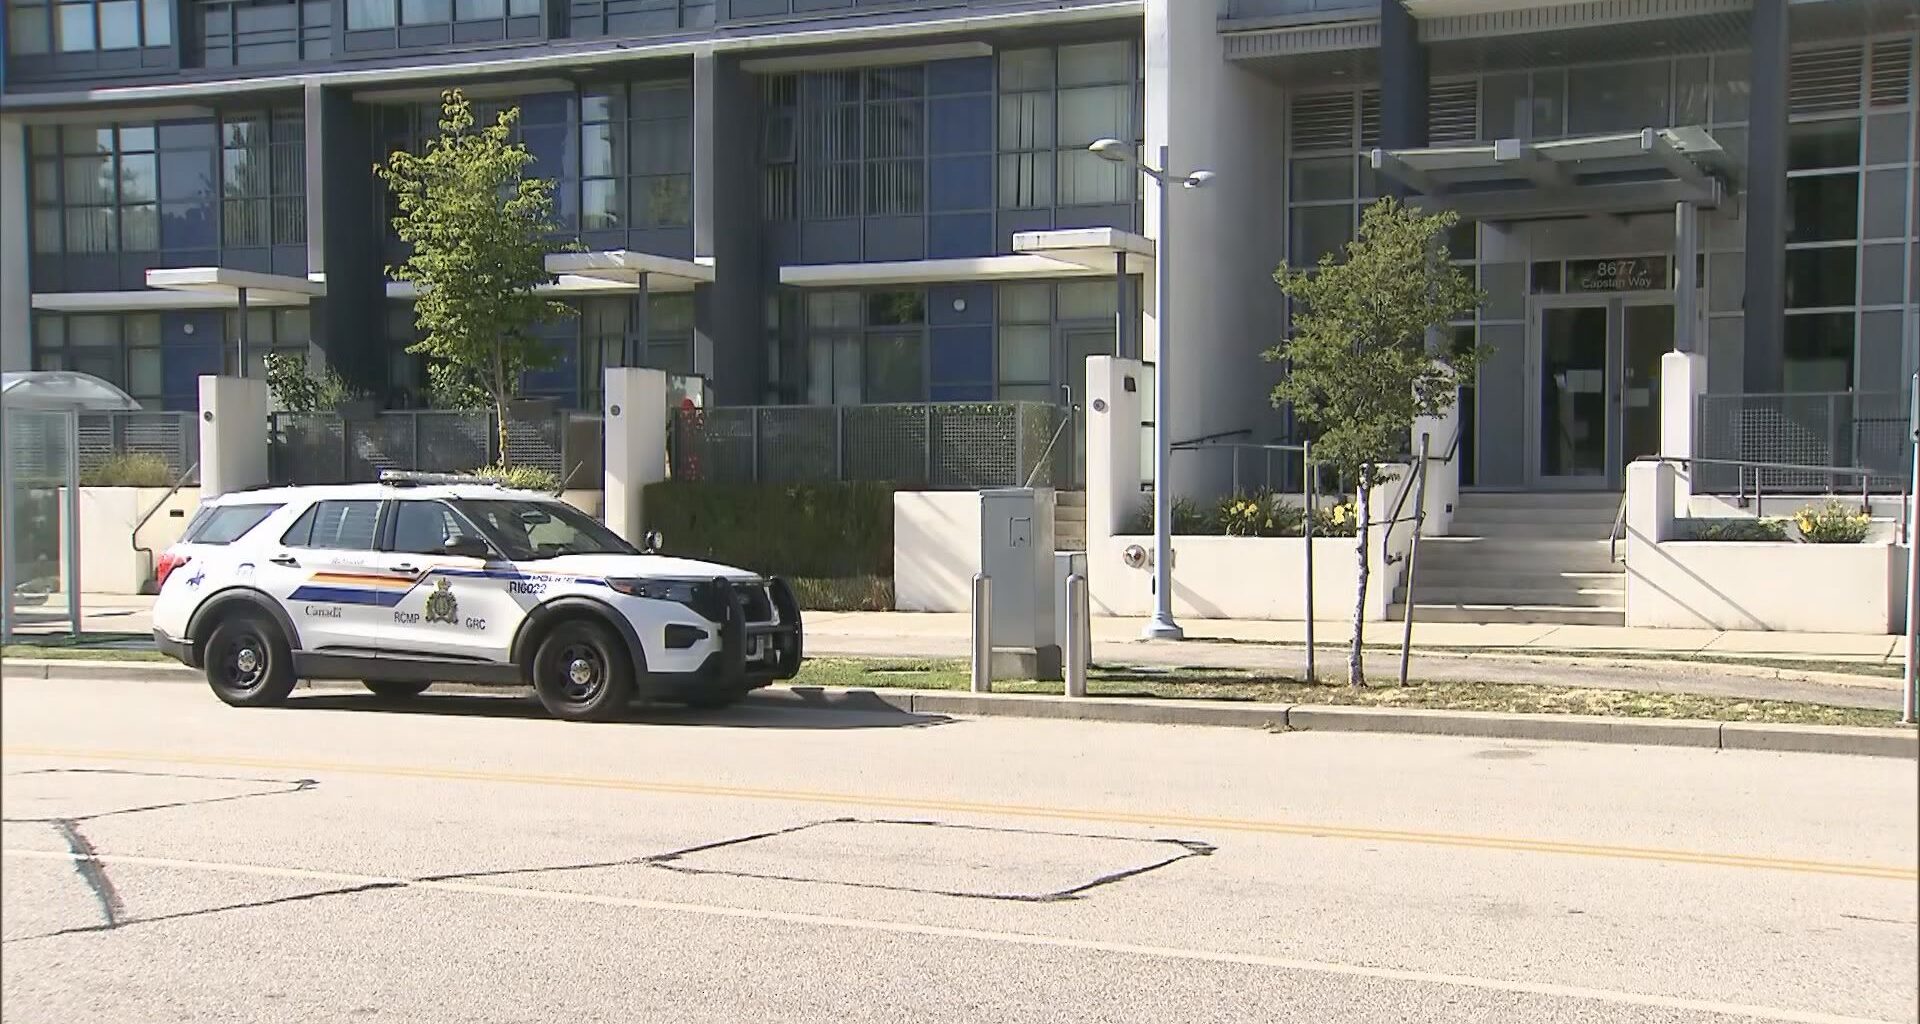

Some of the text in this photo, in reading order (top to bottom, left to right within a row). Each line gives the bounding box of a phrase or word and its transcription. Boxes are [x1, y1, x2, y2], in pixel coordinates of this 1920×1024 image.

[1597, 261, 1637, 277] 8677
[1628, 276, 1652, 289] Way
[305, 605, 342, 619] Canada
[394, 611, 420, 625] RCMP
[465, 616, 487, 631] GRC
